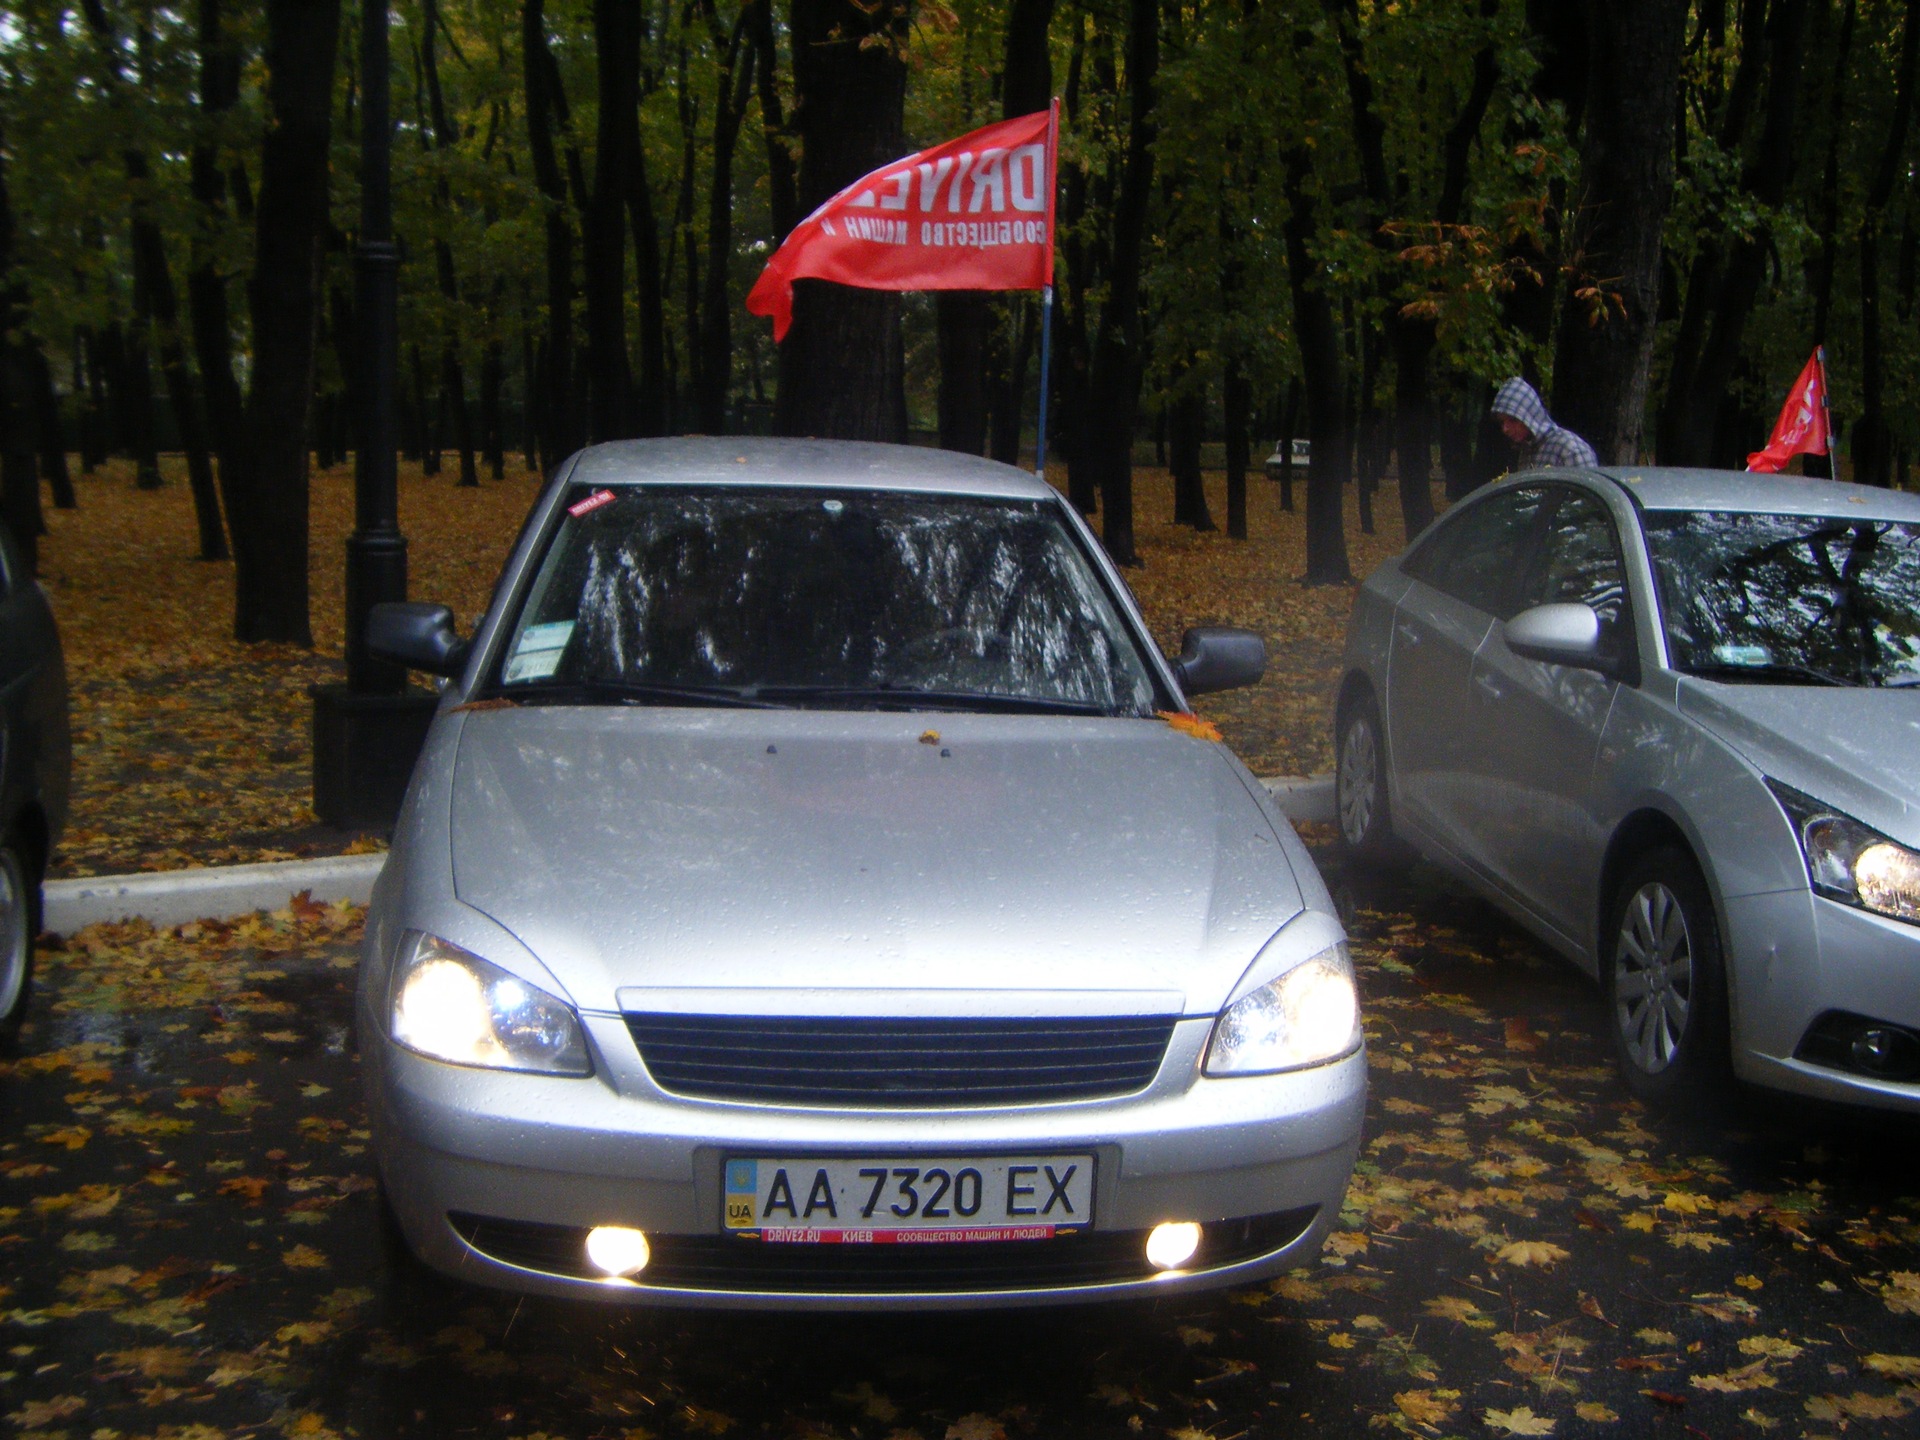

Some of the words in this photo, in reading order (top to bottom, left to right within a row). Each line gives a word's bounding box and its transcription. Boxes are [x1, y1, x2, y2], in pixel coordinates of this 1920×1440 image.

[763, 1168, 837, 1218] AA
[859, 1167, 982, 1217] 7320
[1006, 1165, 1077, 1215] EX
[729, 1204, 751, 1218] UA
[768, 1230, 820, 1242] DRIVE2.RU
[842, 1232, 873, 1242] КИЕВ
[897, 1231, 962, 1242] СООБЩЕСТВО
[965, 1229, 1000, 1240] МАШИН
[1004, 1230, 1010, 1239] И
[1013, 1227, 1046, 1239] ЛЮДЕЙ
